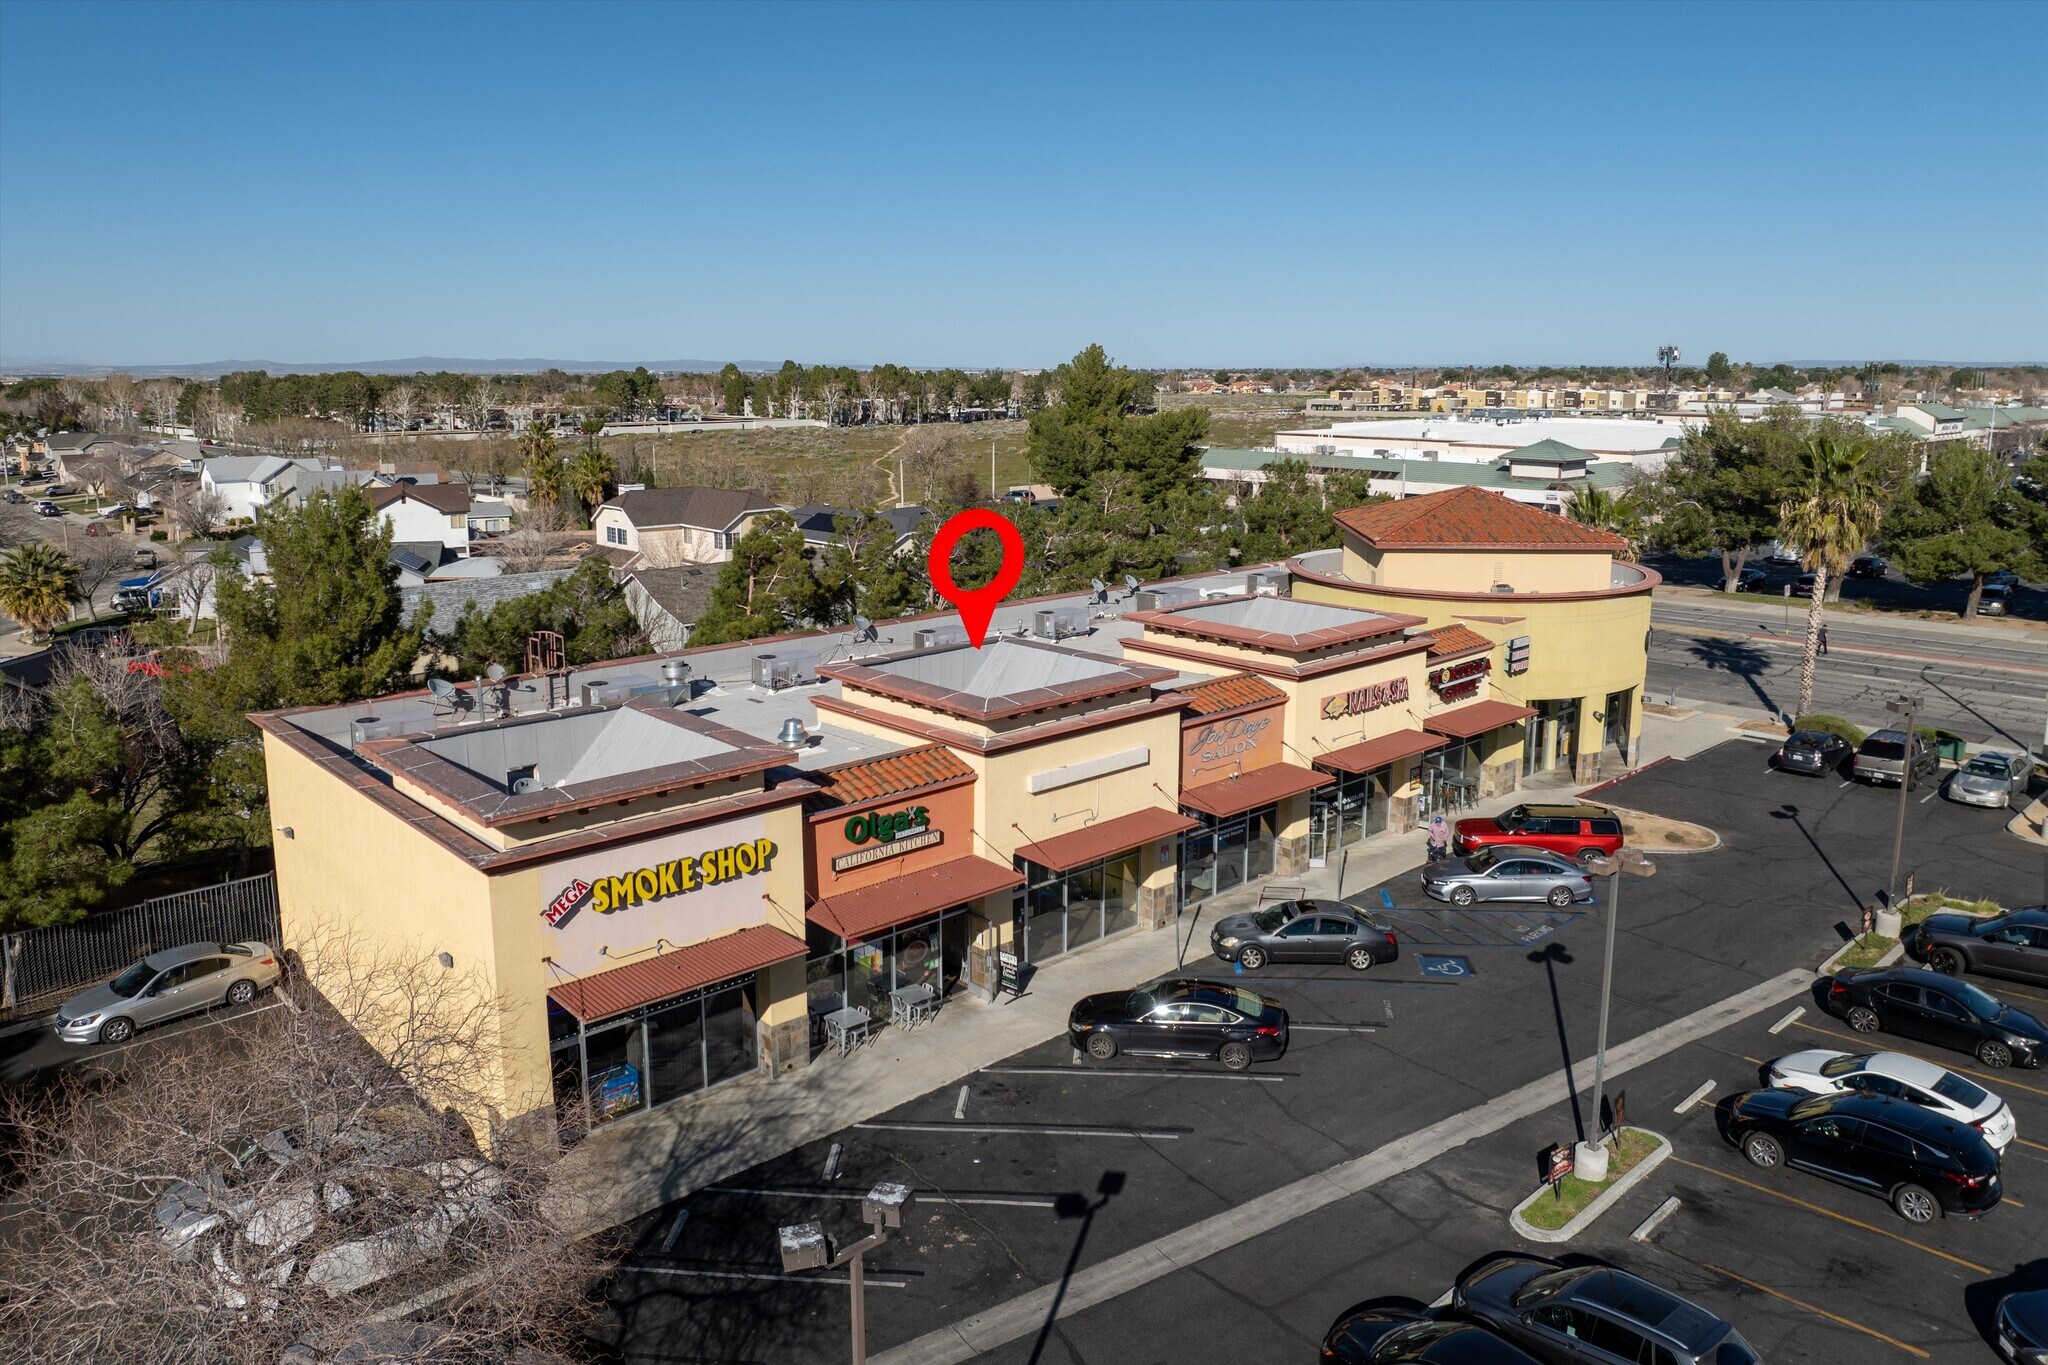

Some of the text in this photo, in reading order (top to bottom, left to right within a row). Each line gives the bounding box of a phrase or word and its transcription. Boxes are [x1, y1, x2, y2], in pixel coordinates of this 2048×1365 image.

[1433, 658, 1492, 686] TORTILLA
[1511, 660, 1529, 672] FOOD
[1348, 685, 1381, 713] NAILS
[1382, 688, 1390, 704] &
[1391, 677, 1409, 700] SPA
[1444, 678, 1479, 699] GRILL
[1189, 717, 1271, 755] Jon Dave
[1202, 738, 1258, 762] SALON
[845, 806, 929, 845] Olga's
[837, 830, 940, 869] CALIFORNIA KITCHEN
[544, 838, 773, 925] MEGA SMOKE SHOP
[1521, 925, 1554, 942] PARKING
